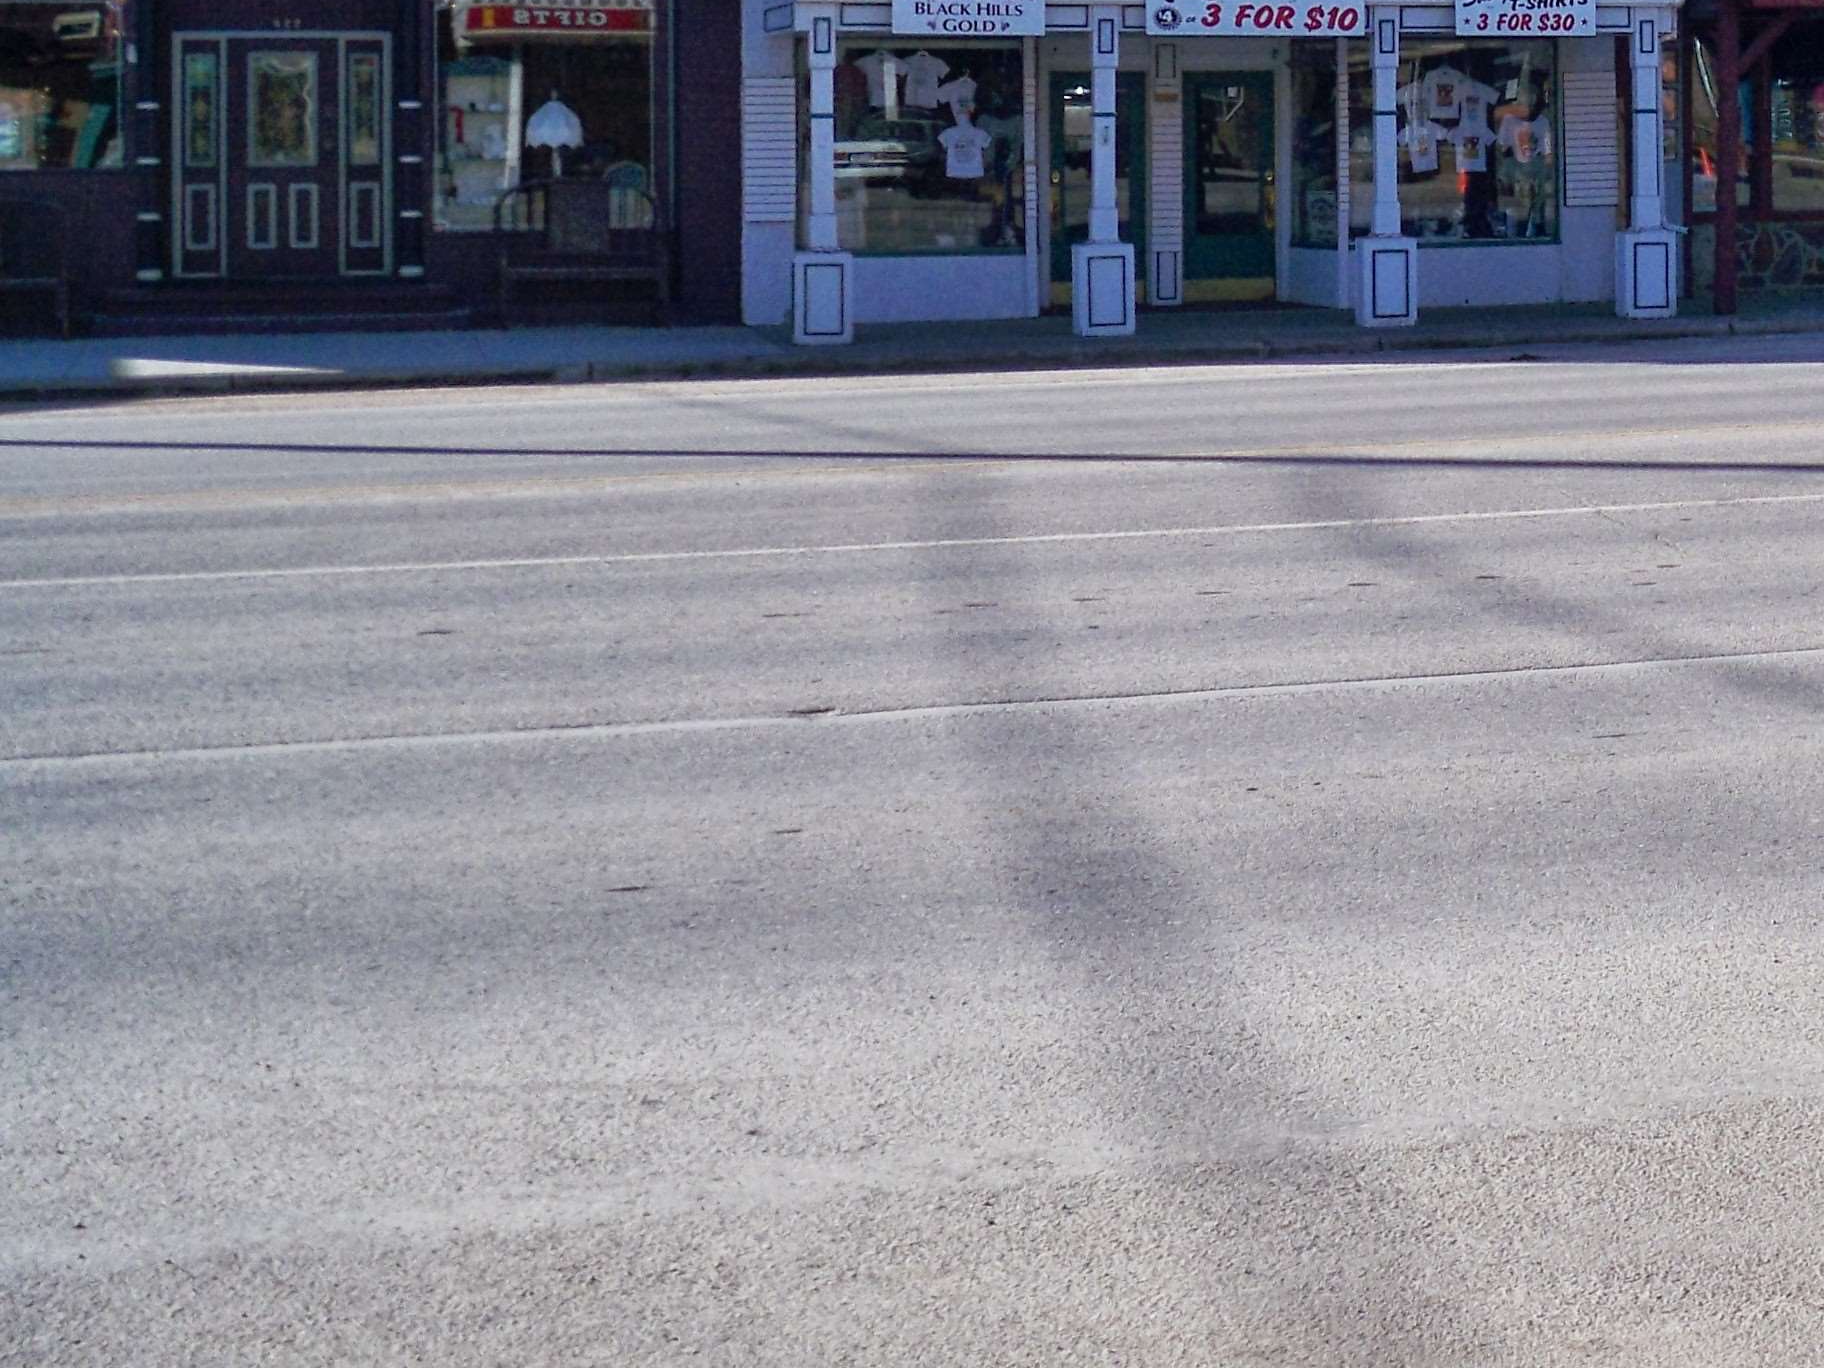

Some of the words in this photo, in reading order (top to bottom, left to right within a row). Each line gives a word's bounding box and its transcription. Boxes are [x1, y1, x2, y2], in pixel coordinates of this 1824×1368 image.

[914, 1, 971, 16] BLACK
[976, 2, 1024, 17] HILLS
[1200, 3, 1222, 28] 3
[1234, 4, 1296, 30] FOR
[1303, 4, 1359, 32] $10
[942, 18, 997, 33] GOLD
[1476, 13, 1489, 31] 3
[1496, 13, 1533, 31] FOR
[1537, 13, 1576, 32] $30
